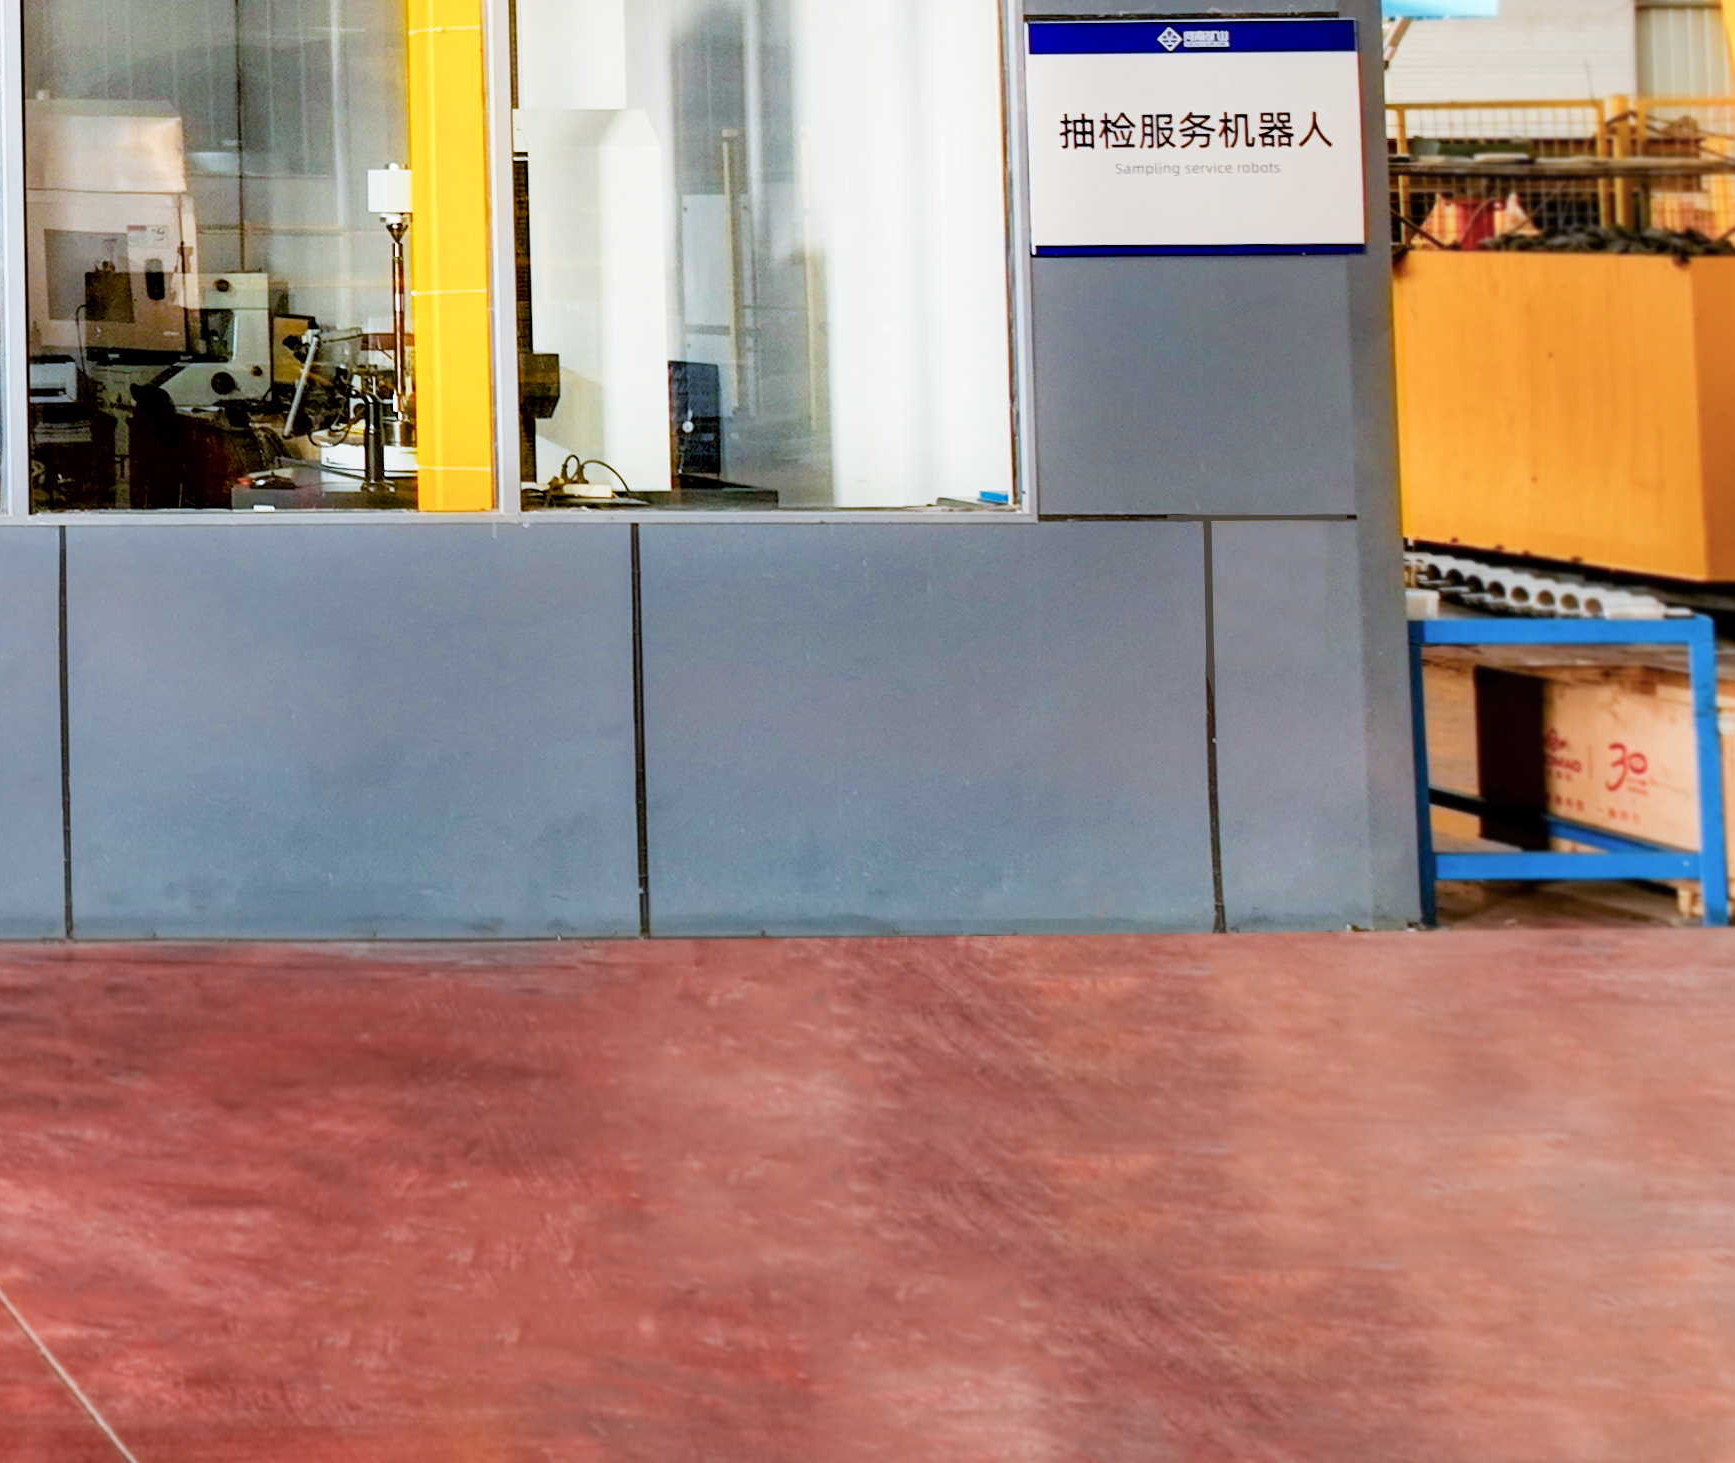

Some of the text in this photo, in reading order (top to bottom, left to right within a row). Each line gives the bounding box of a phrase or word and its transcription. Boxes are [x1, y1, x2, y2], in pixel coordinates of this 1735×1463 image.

[1058, 111, 1333, 149] 抽检服务机器人
[1115, 162, 1281, 177] Sampling service robots
